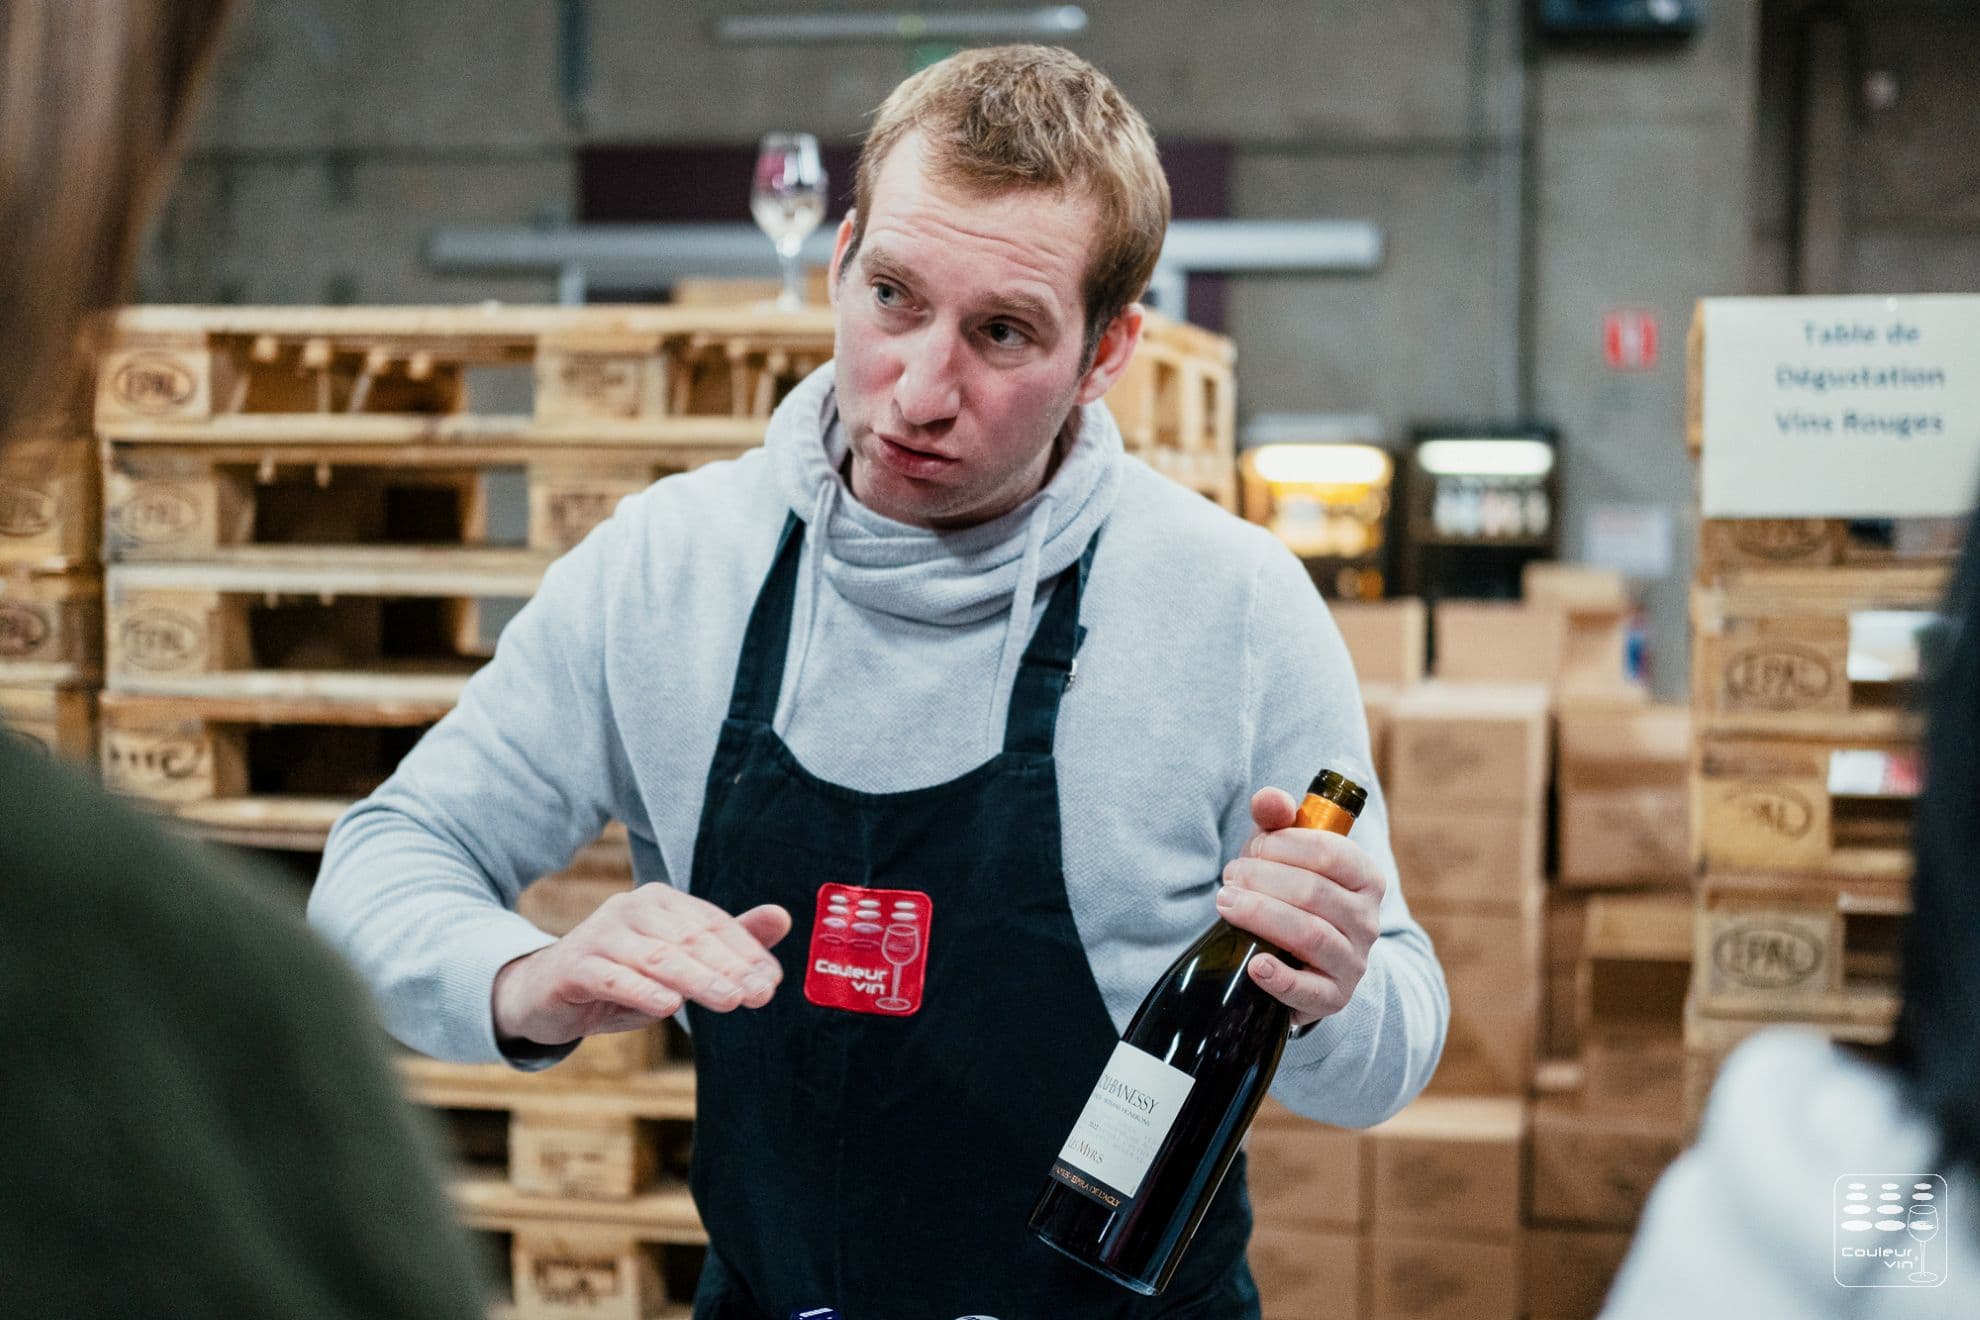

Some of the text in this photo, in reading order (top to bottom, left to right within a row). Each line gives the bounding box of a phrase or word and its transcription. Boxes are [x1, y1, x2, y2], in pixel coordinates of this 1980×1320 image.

[1803, 319, 1920, 343] Table de
[1776, 412, 1943, 437] Vins Rouges
[814, 958, 888, 981] Couleur
[850, 980, 886, 995] vin
